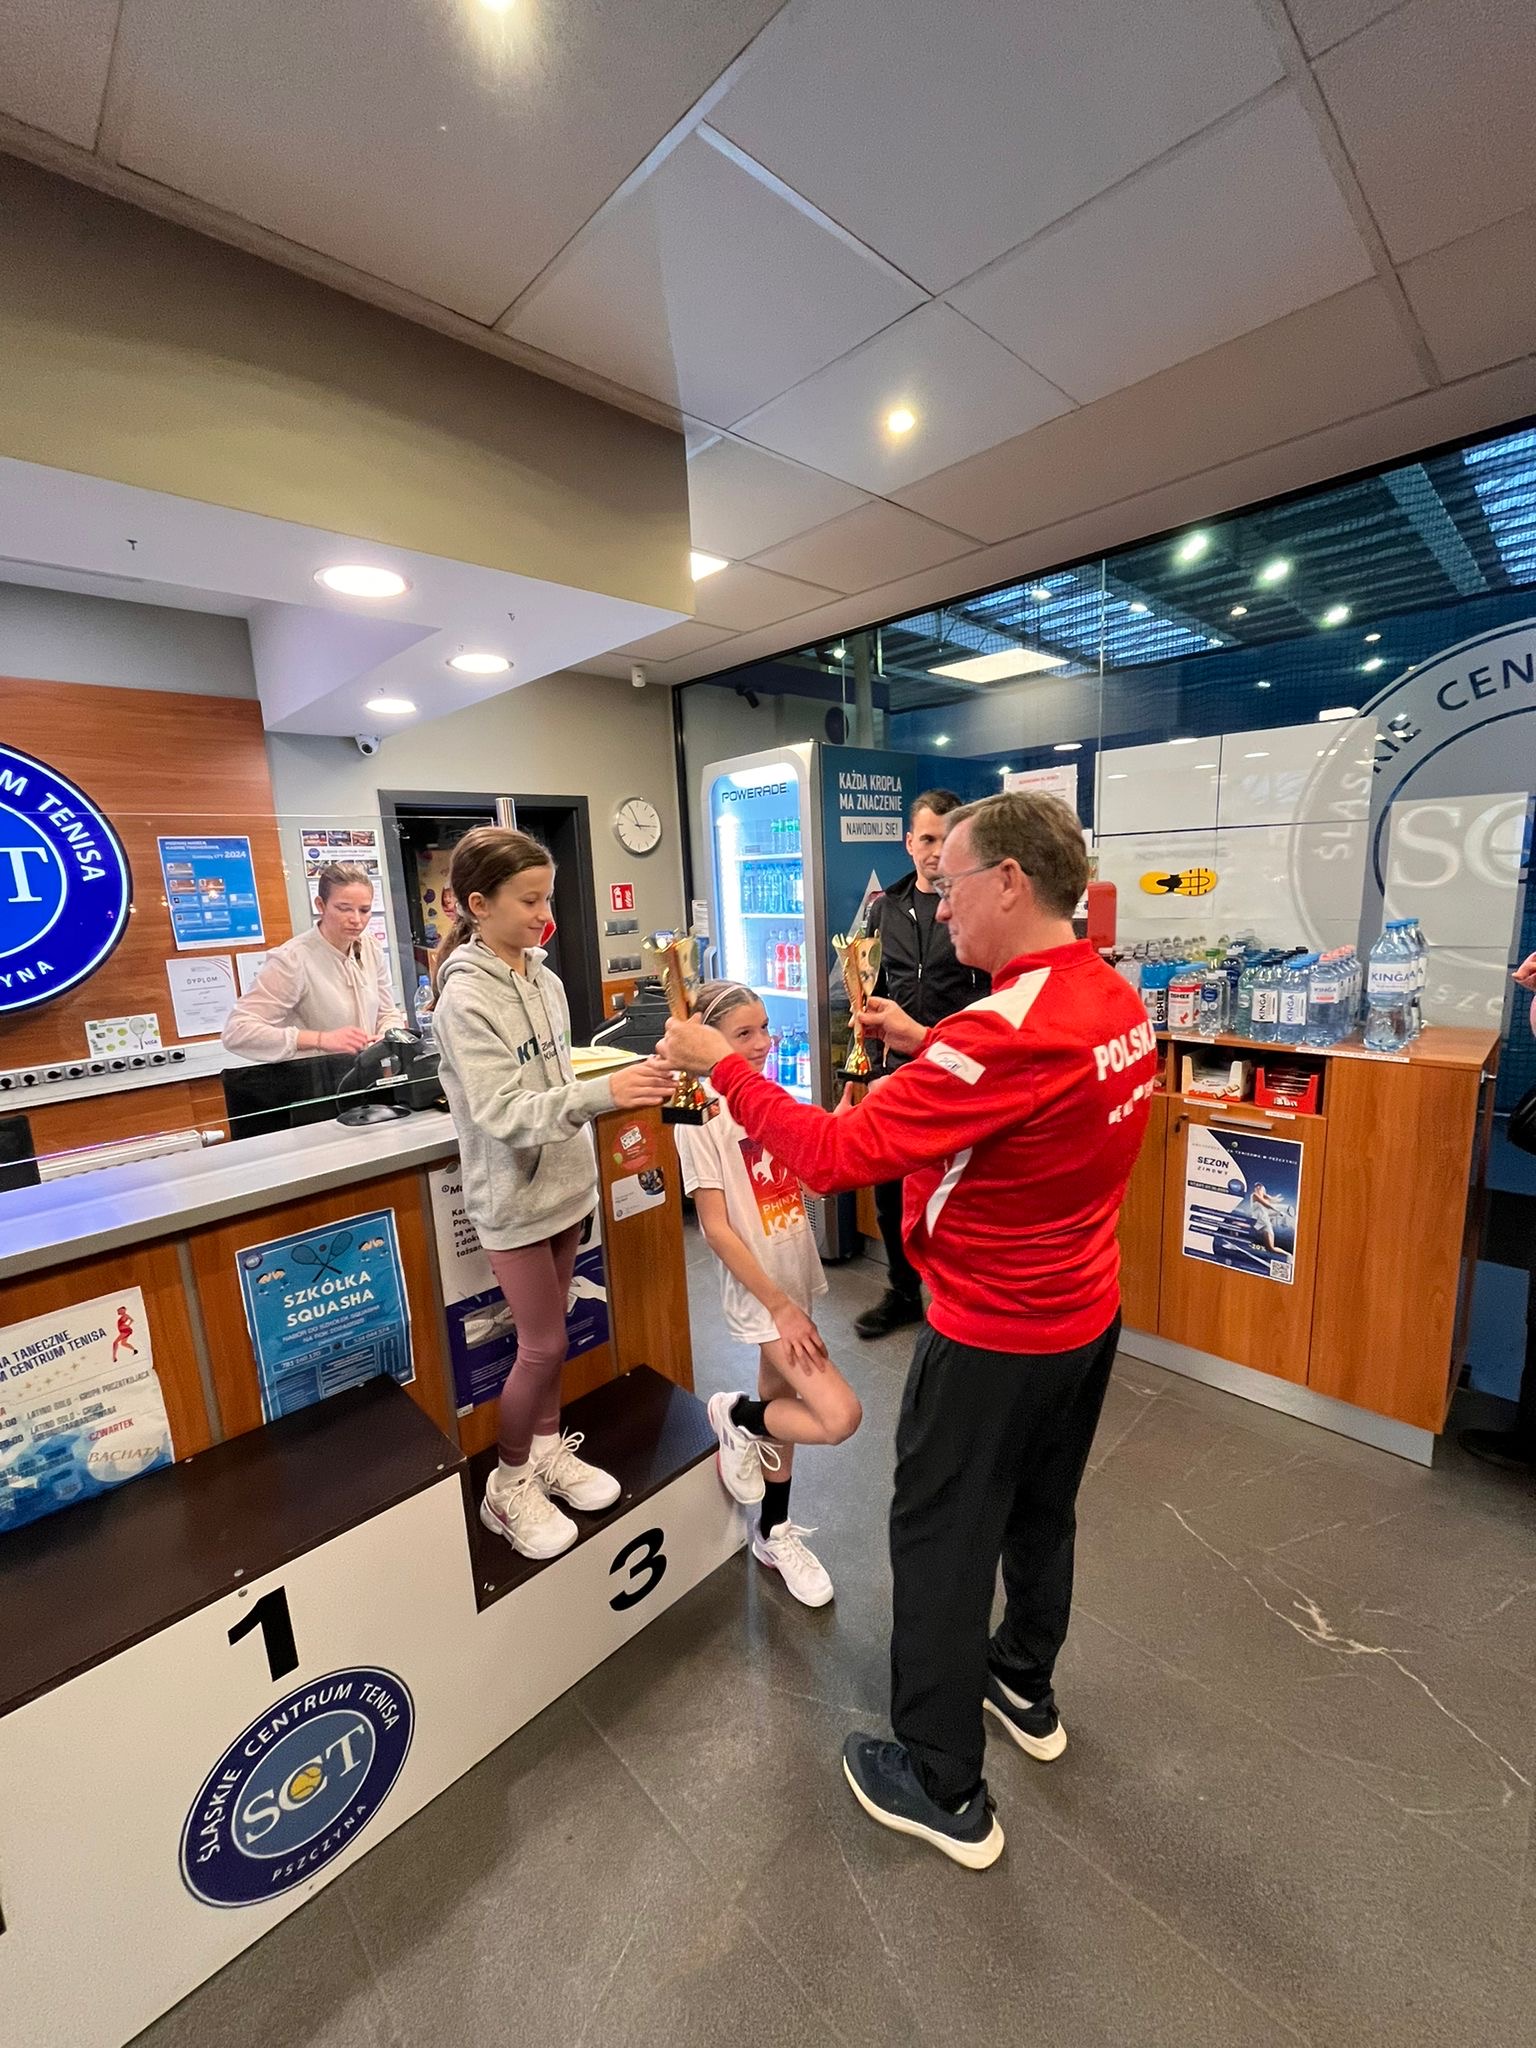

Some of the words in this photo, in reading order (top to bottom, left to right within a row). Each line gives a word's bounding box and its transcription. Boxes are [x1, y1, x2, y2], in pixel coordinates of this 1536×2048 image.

[1436, 653, 1535, 711] CEN
[722, 782, 787, 802] POWERADE
[839, 769, 868, 790] KAŻDA
[869, 775, 902, 792] KROPLA
[839, 793, 855, 810] MA
[857, 795, 902, 812] ZNACZENIE
[38, 792, 106, 881] TENISA
[846, 822, 883, 836] NAWODNIJ
[224, 851, 247, 859] 2024
[1371, 971, 1410, 982] KINGA
[1286, 994, 1295, 1022] KINGA
[1197, 1156, 1230, 1169] SEZON
[283, 1270, 372, 1309] SZKÓŁKA
[286, 1289, 374, 1327] SQUASHA
[10, 1345, 66, 1377] CENTRUM
[67, 1327, 107, 1352] TENISA
[12, 1329, 72, 1362] TANECZNE
[88, 1418, 134, 1441] CZWARTEK
[88, 1446, 161, 1463] BACHATA
[609, 1527, 668, 1612] 3
[227, 1585, 300, 1683] 1
[196, 1769, 241, 1864] ŚLĄSKIE
[244, 1682, 352, 1758] CENTRUM
[360, 1682, 400, 1731] TENISA
[242, 1724, 367, 1844] SCT
[271, 1804, 367, 1881] PSZCZYNA
